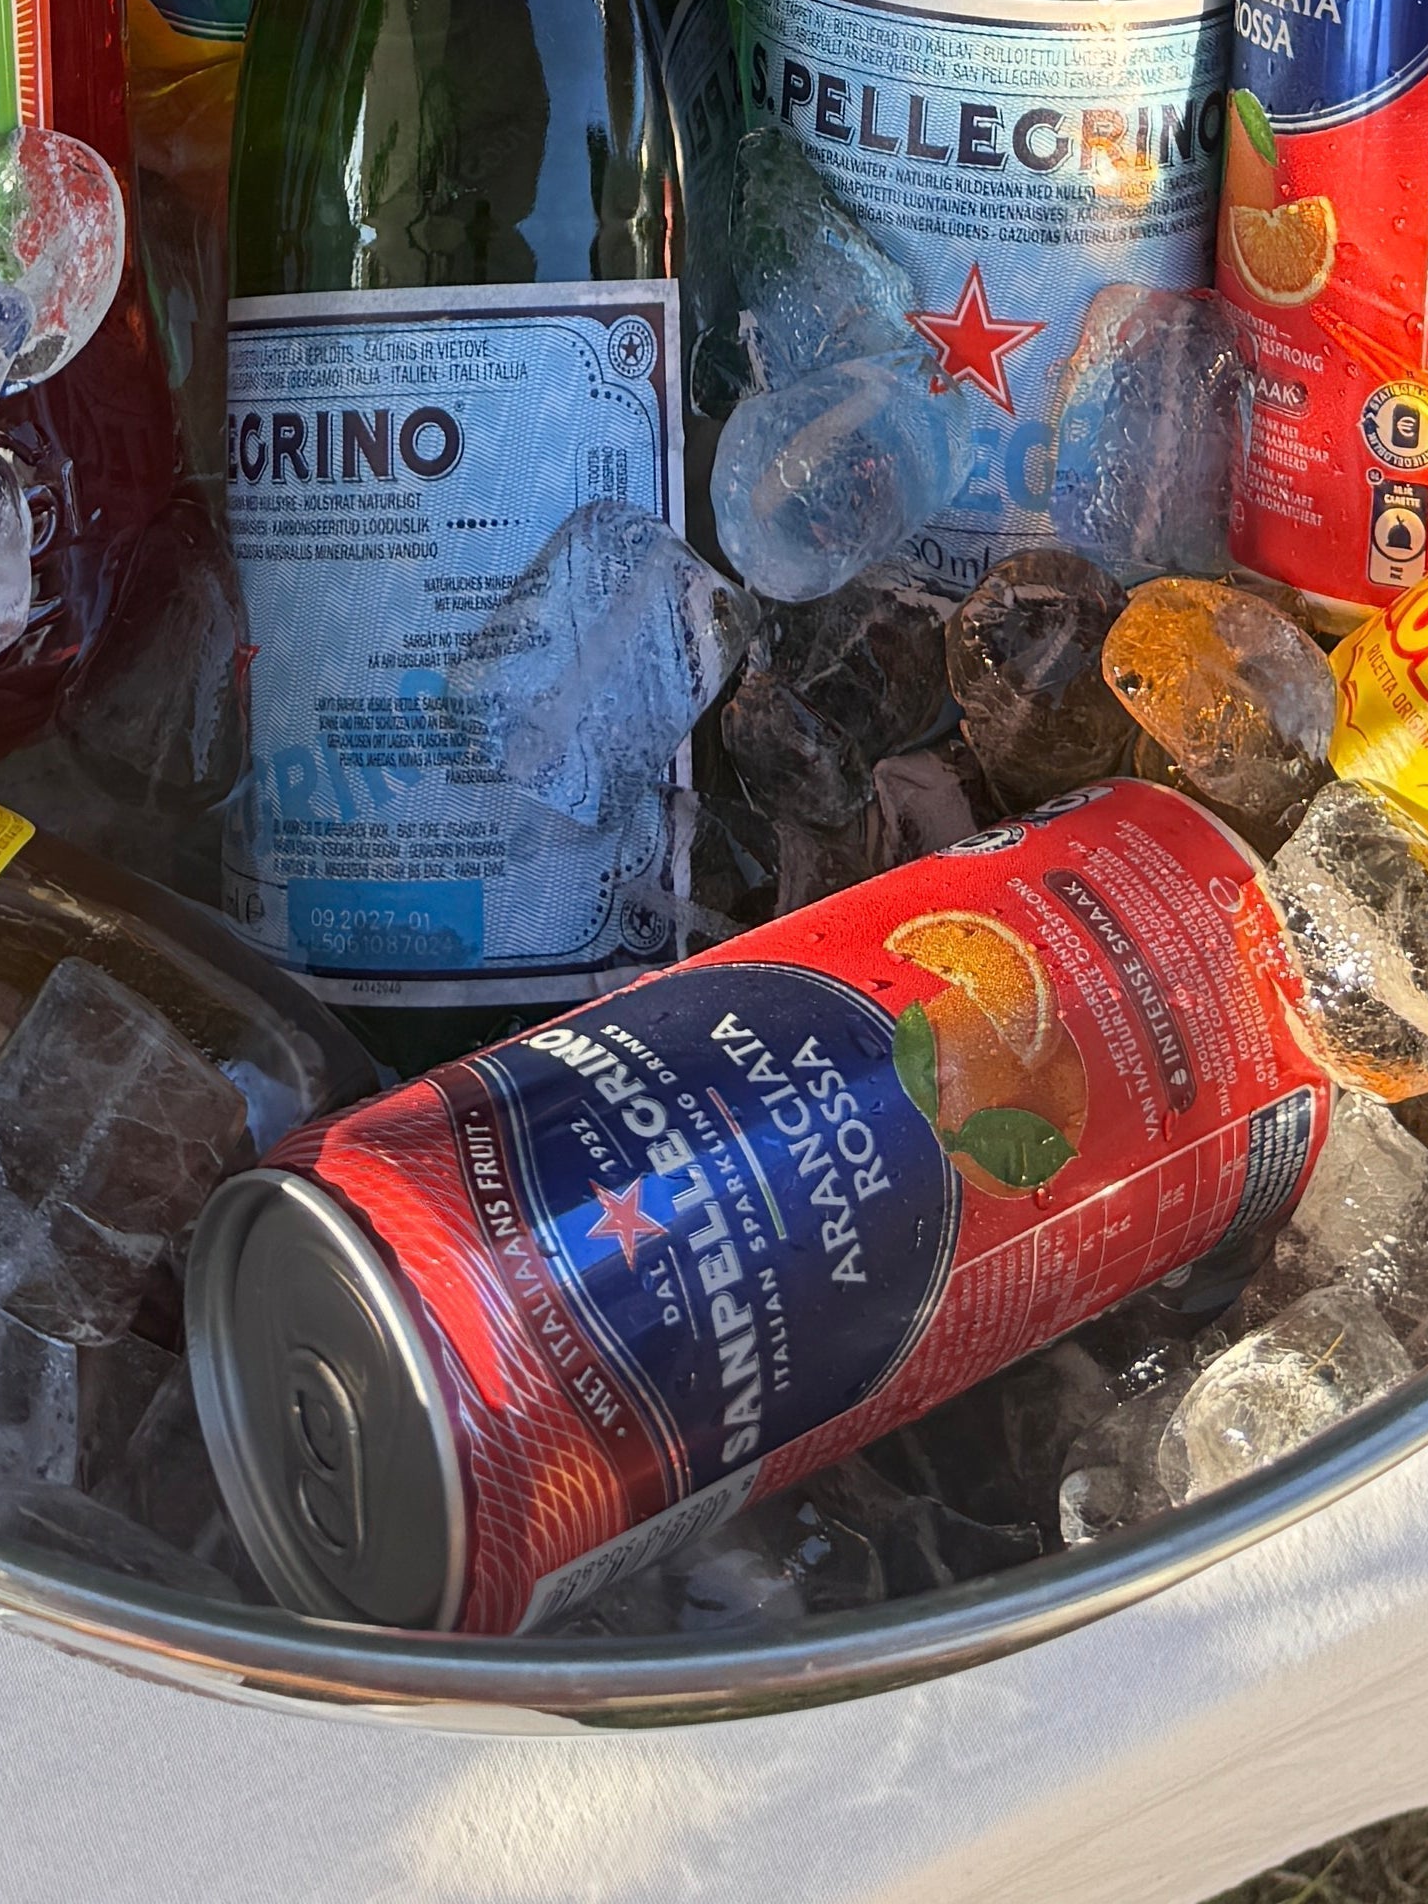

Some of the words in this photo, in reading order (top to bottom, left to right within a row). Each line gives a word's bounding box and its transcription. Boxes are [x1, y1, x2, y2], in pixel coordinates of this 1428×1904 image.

[750, 42, 1225, 175] S.PELLEGRINO
[1366, 642, 1399, 700] RICETTA
[310, 908, 395, 931] 09.2027
[408, 911, 430, 931] 01
[1006, 876, 1091, 963] OORSPRONG
[1061, 879, 1130, 955] SMAAK
[1086, 966, 1152, 1094] NATUURLIJKE
[1122, 955, 1182, 1065] INTENSE
[599, 1023, 680, 1087] DRINKS
[1108, 1042, 1133, 1077] MET
[469, 1121, 505, 1192] FRUIT
[570, 1117, 617, 1174] 1932
[709, 1011, 869, 1284] ARANCIATA
[790, 1034, 892, 1203] ROSSA
[1140, 1095, 1163, 1142] VAN
[675, 1090, 768, 1254] SPARKLING
[484, 1199, 573, 1368] ITALIAANS
[526, 1028, 764, 1466] SANPELLEGRINO
[649, 1257, 681, 1327] DAL
[759, 1267, 793, 1392] ITALIAN
[573, 1366, 621, 1428] MET
